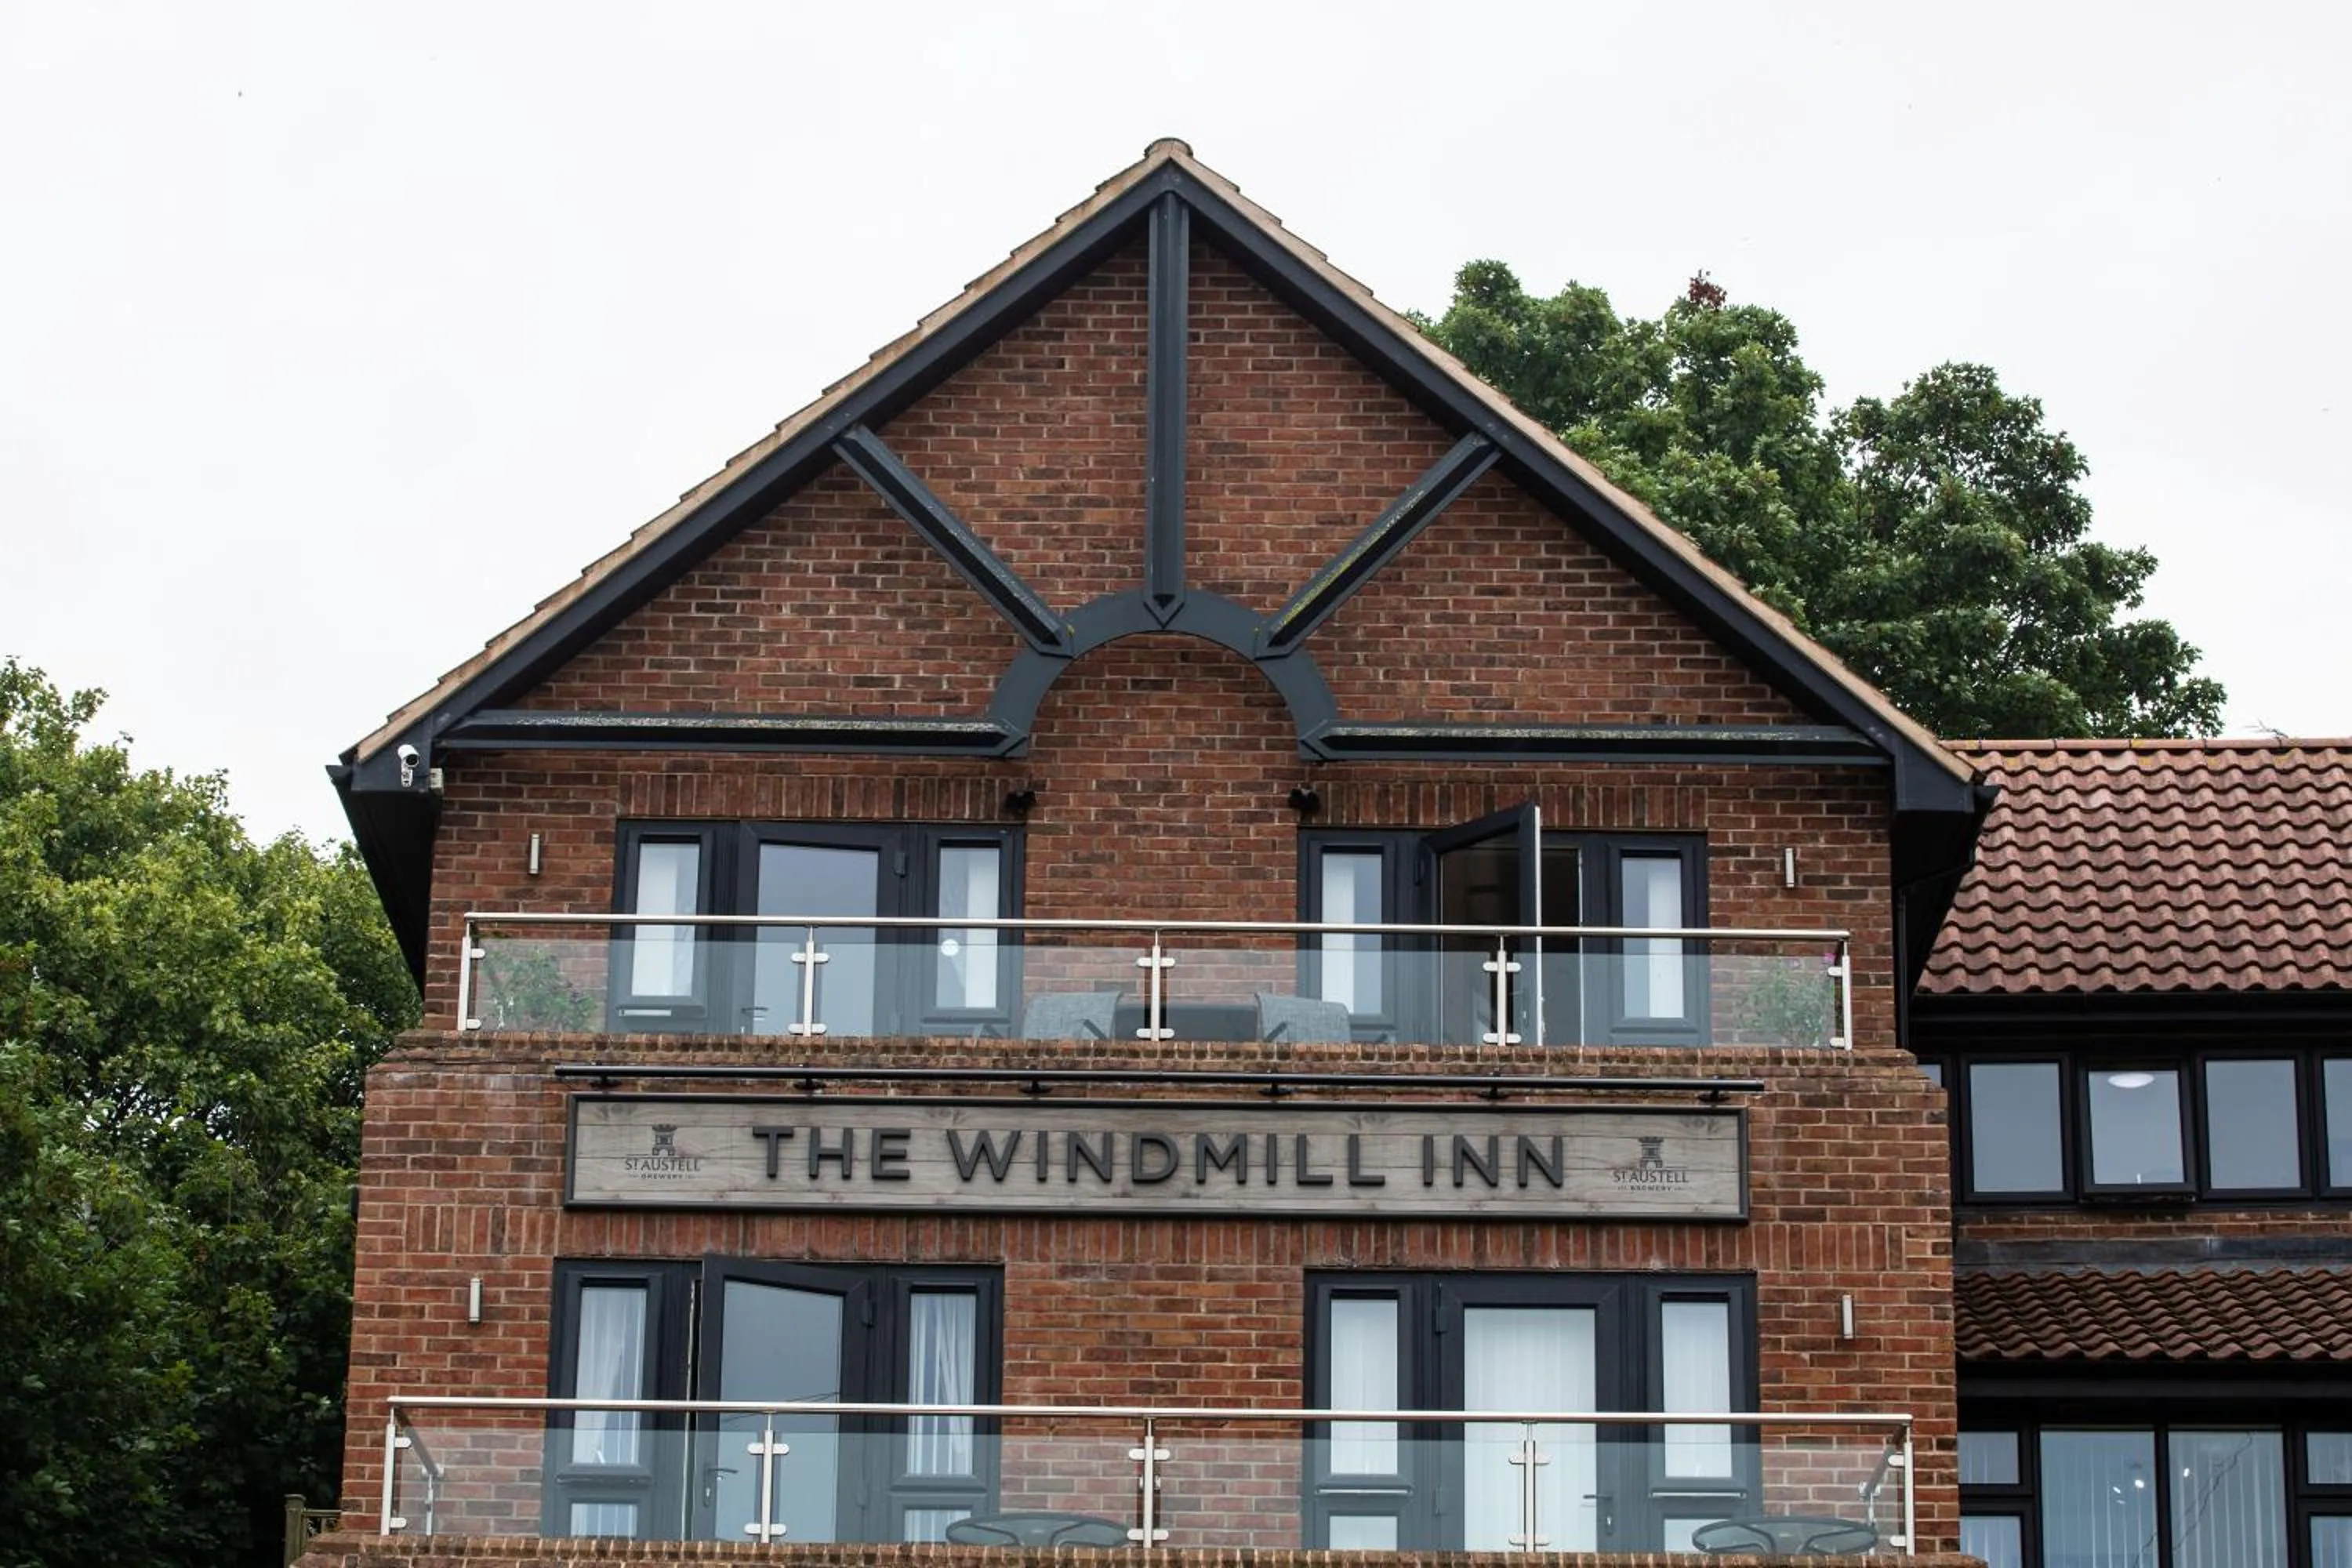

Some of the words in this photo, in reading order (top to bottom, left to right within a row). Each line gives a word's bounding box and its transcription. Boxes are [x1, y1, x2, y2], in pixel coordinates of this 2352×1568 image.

[752, 1126, 911, 1180] THE
[946, 1129, 1386, 1186] WINDMILL
[1423, 1134, 1563, 1187] INN
[641, 1159, 701, 1172] AUSTELL
[1629, 1170, 1690, 1183] AUSTELL
